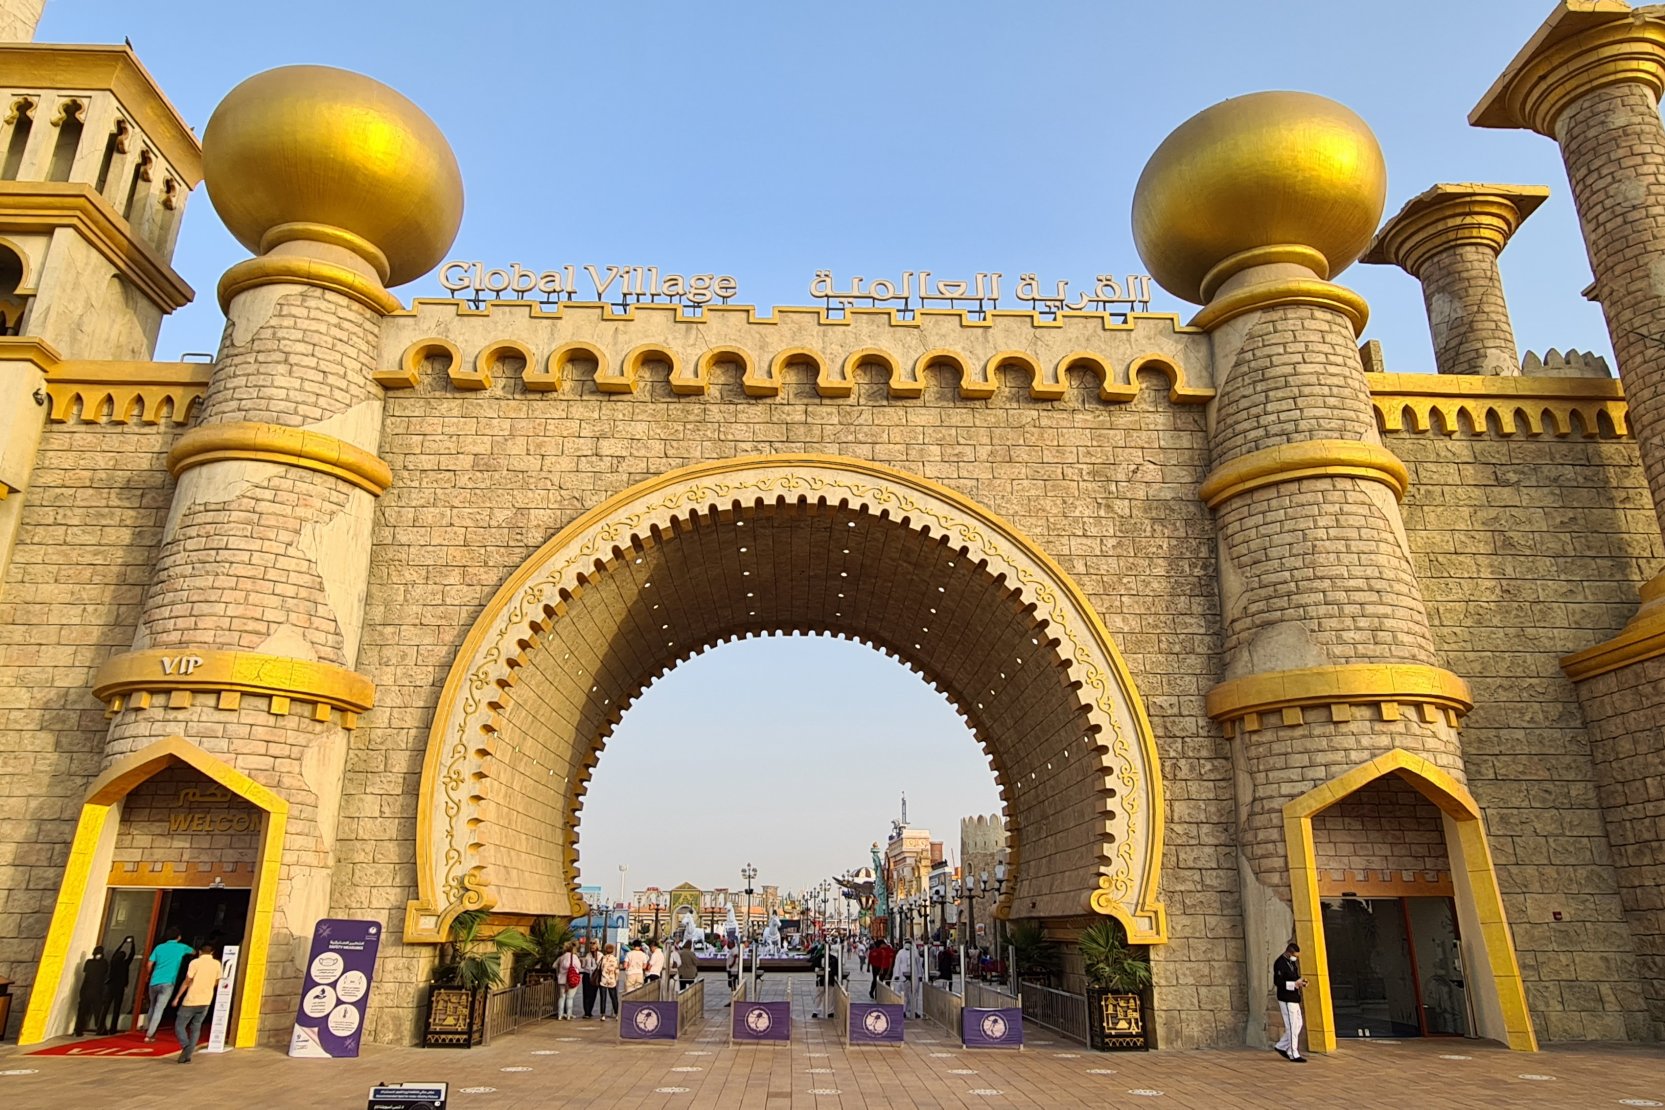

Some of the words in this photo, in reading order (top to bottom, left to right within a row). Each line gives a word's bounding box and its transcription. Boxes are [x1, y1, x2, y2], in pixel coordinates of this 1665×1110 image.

[438, 260, 577, 294] Global
[584, 264, 737, 303] Village
[808, 269, 1003, 308] العالمية
[1015, 273, 1152, 310] القرية
[162, 655, 204, 675] VIP
[65, 1047, 155, 1055] VIP
